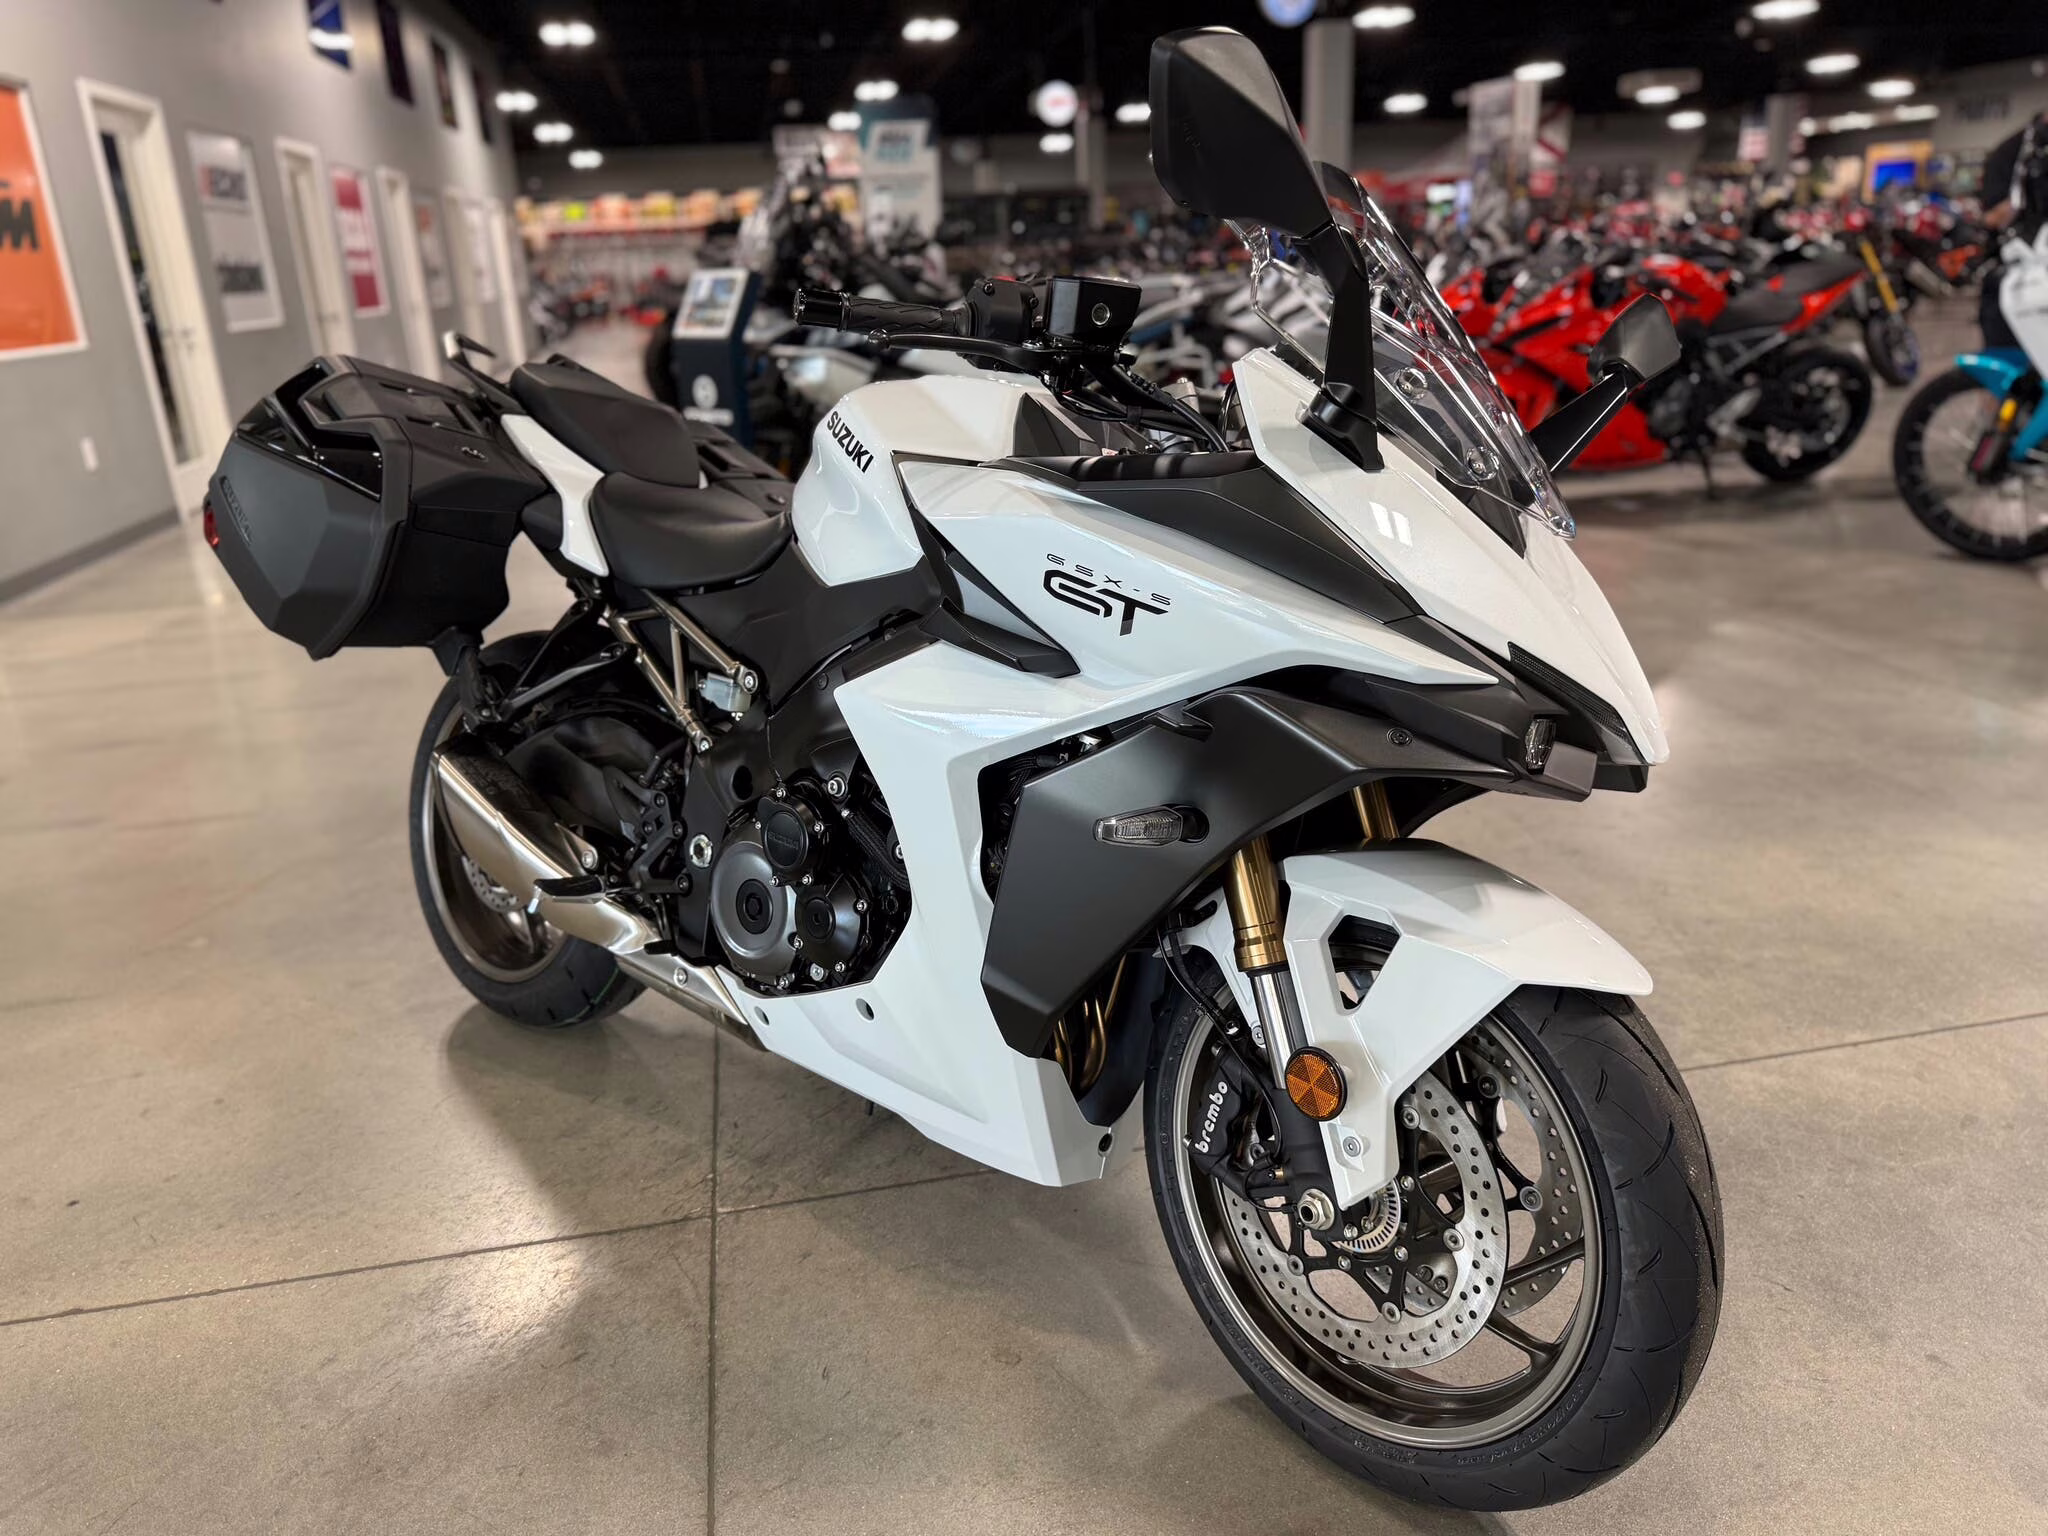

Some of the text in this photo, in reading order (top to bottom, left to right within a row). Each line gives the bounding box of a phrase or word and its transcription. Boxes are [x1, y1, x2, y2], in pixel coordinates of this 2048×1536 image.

[827, 410, 874, 474] SUZUKI
[1043, 569, 1169, 637] GT
[1046, 553, 1171, 606] GSX-S
[1194, 1081, 1228, 1153] brembo
